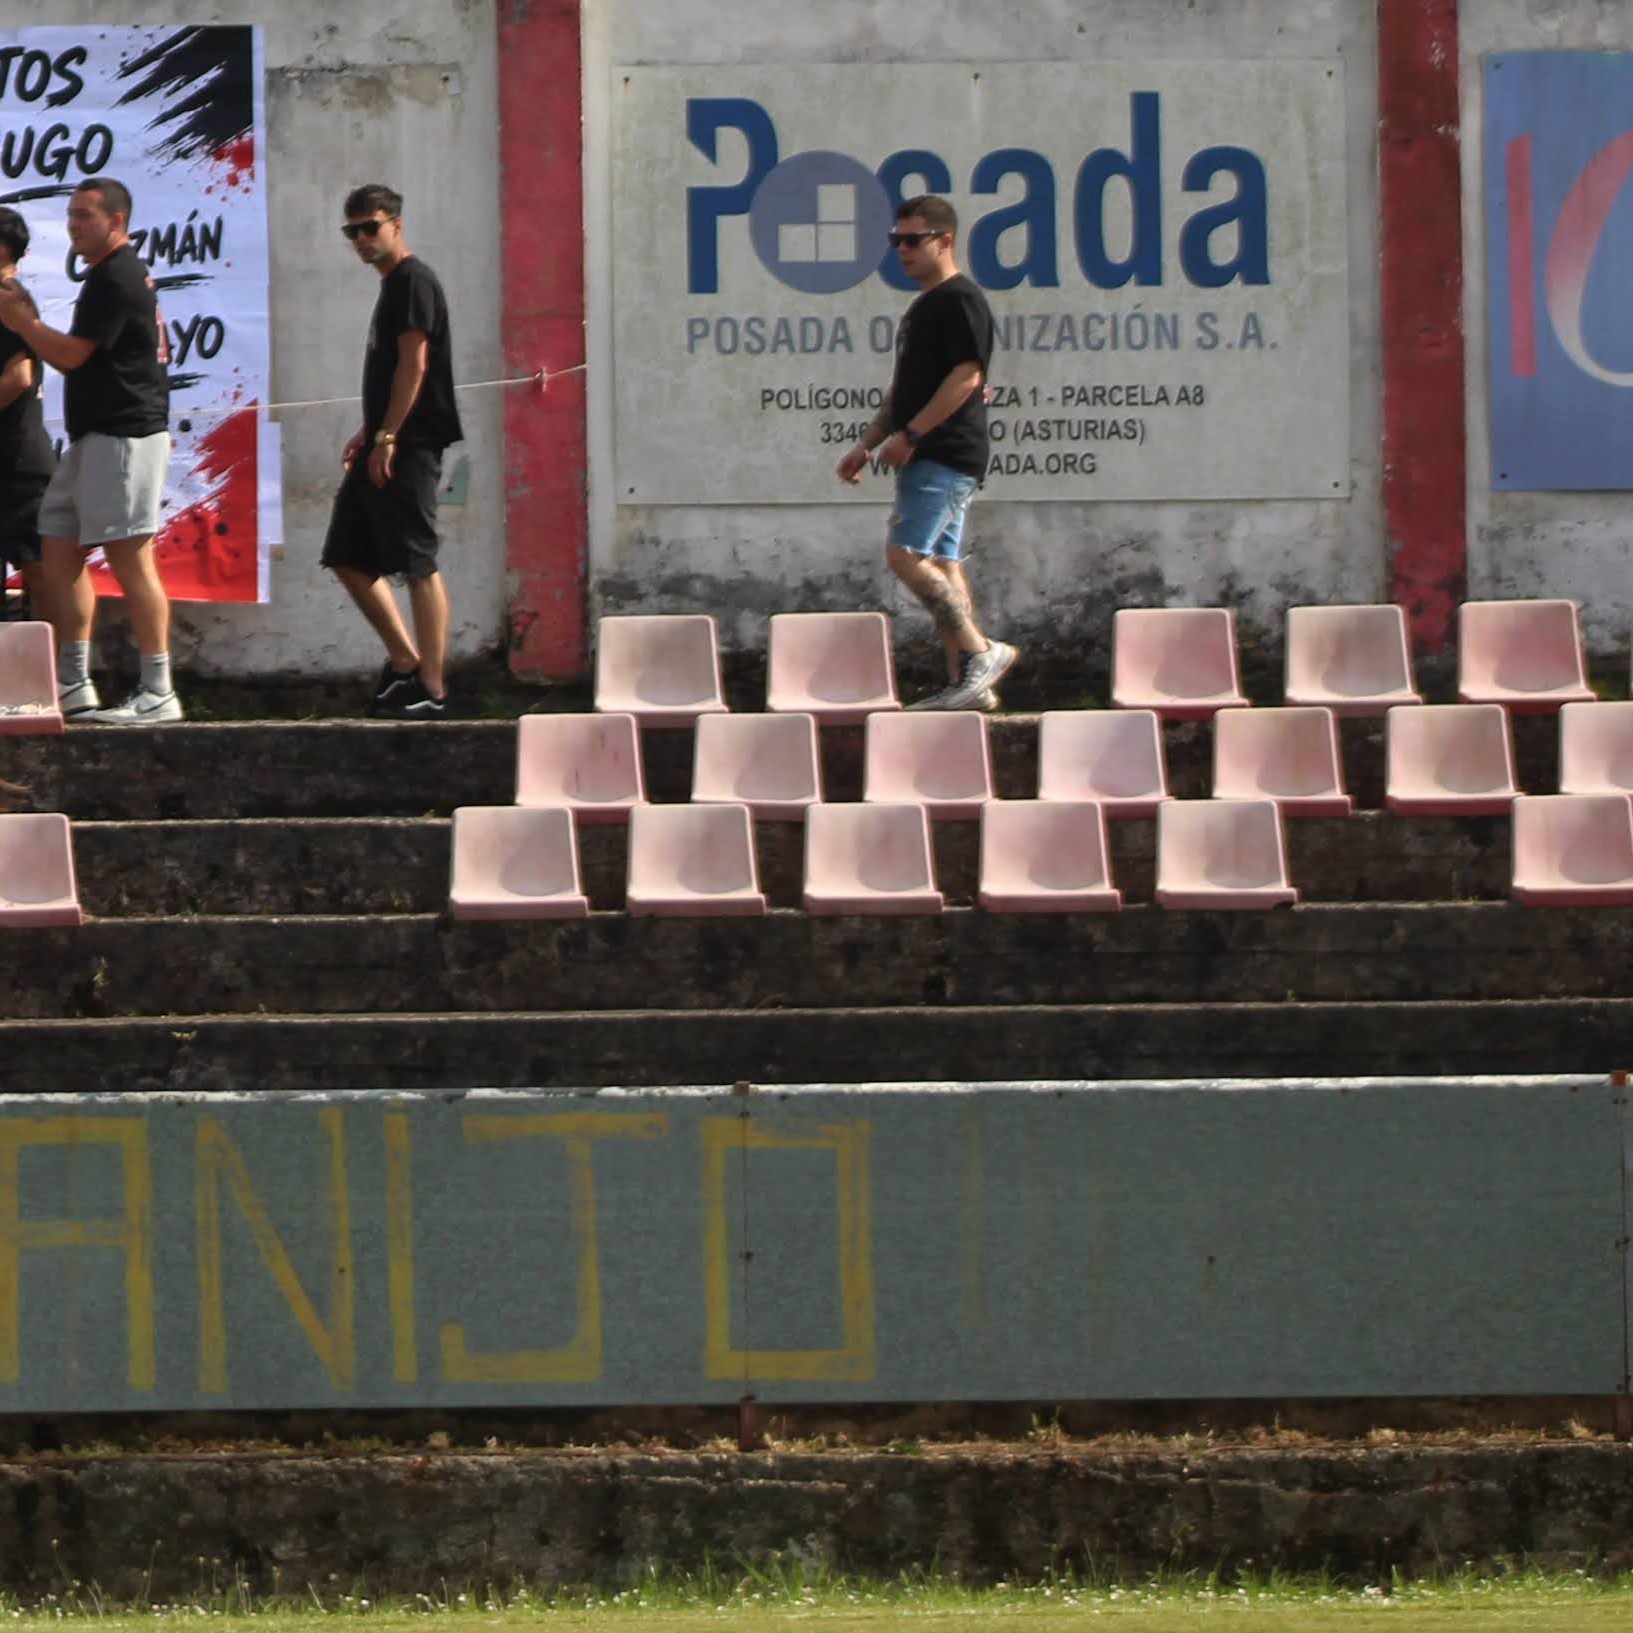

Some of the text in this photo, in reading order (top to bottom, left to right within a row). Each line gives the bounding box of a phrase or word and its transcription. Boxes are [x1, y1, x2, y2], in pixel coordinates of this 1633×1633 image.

[685, 91, 1272, 295] Posada
[686, 306, 1278, 355] POSADA ONIZACIÓN S.A.
[761, 381, 884, 411] POLÍGONO
[1062, 385, 1171, 407] PARCELA
[1175, 385, 1206, 406] A8
[1014, 418, 1147, 445] (ASTURIAS)
